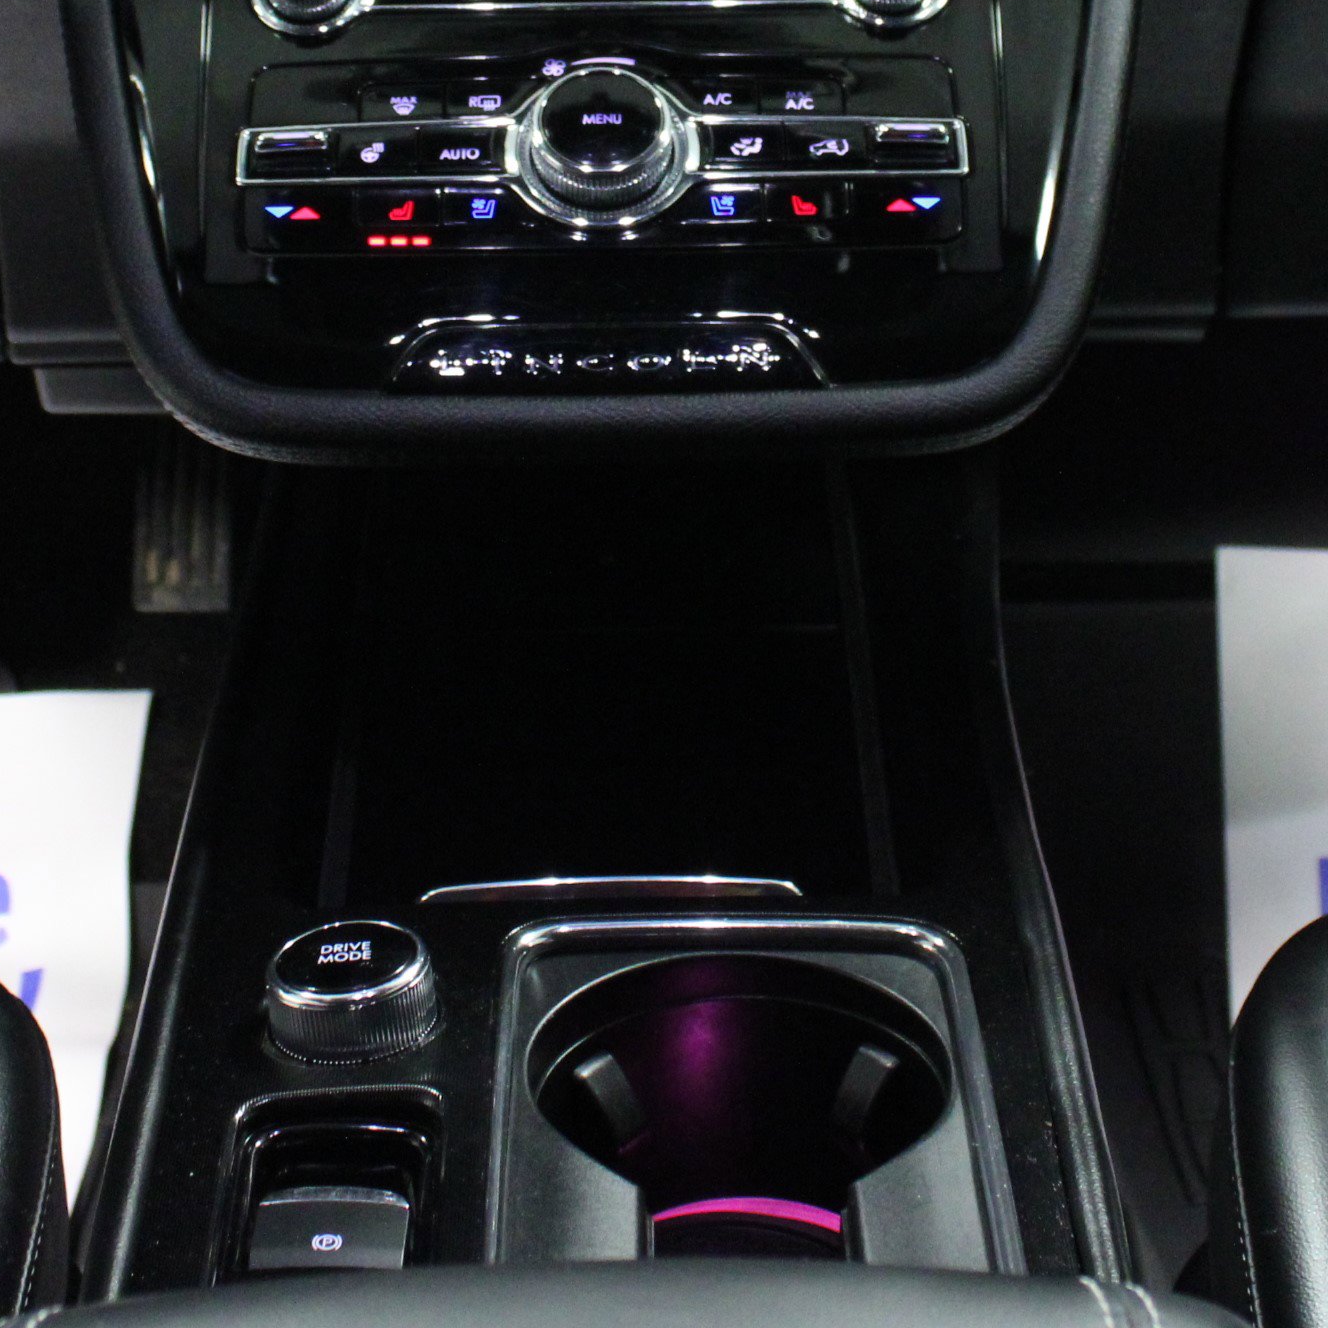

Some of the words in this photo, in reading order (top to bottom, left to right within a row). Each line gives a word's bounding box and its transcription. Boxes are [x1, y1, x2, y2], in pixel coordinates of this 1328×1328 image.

[389, 96, 419, 105] MAX
[702, 92, 733, 106] A/C
[784, 97, 816, 111] A/C
[581, 112, 623, 126] MENU
[439, 147, 481, 161] AUTO
[320, 940, 371, 956] DRIVE
[317, 950, 372, 965] MODE
